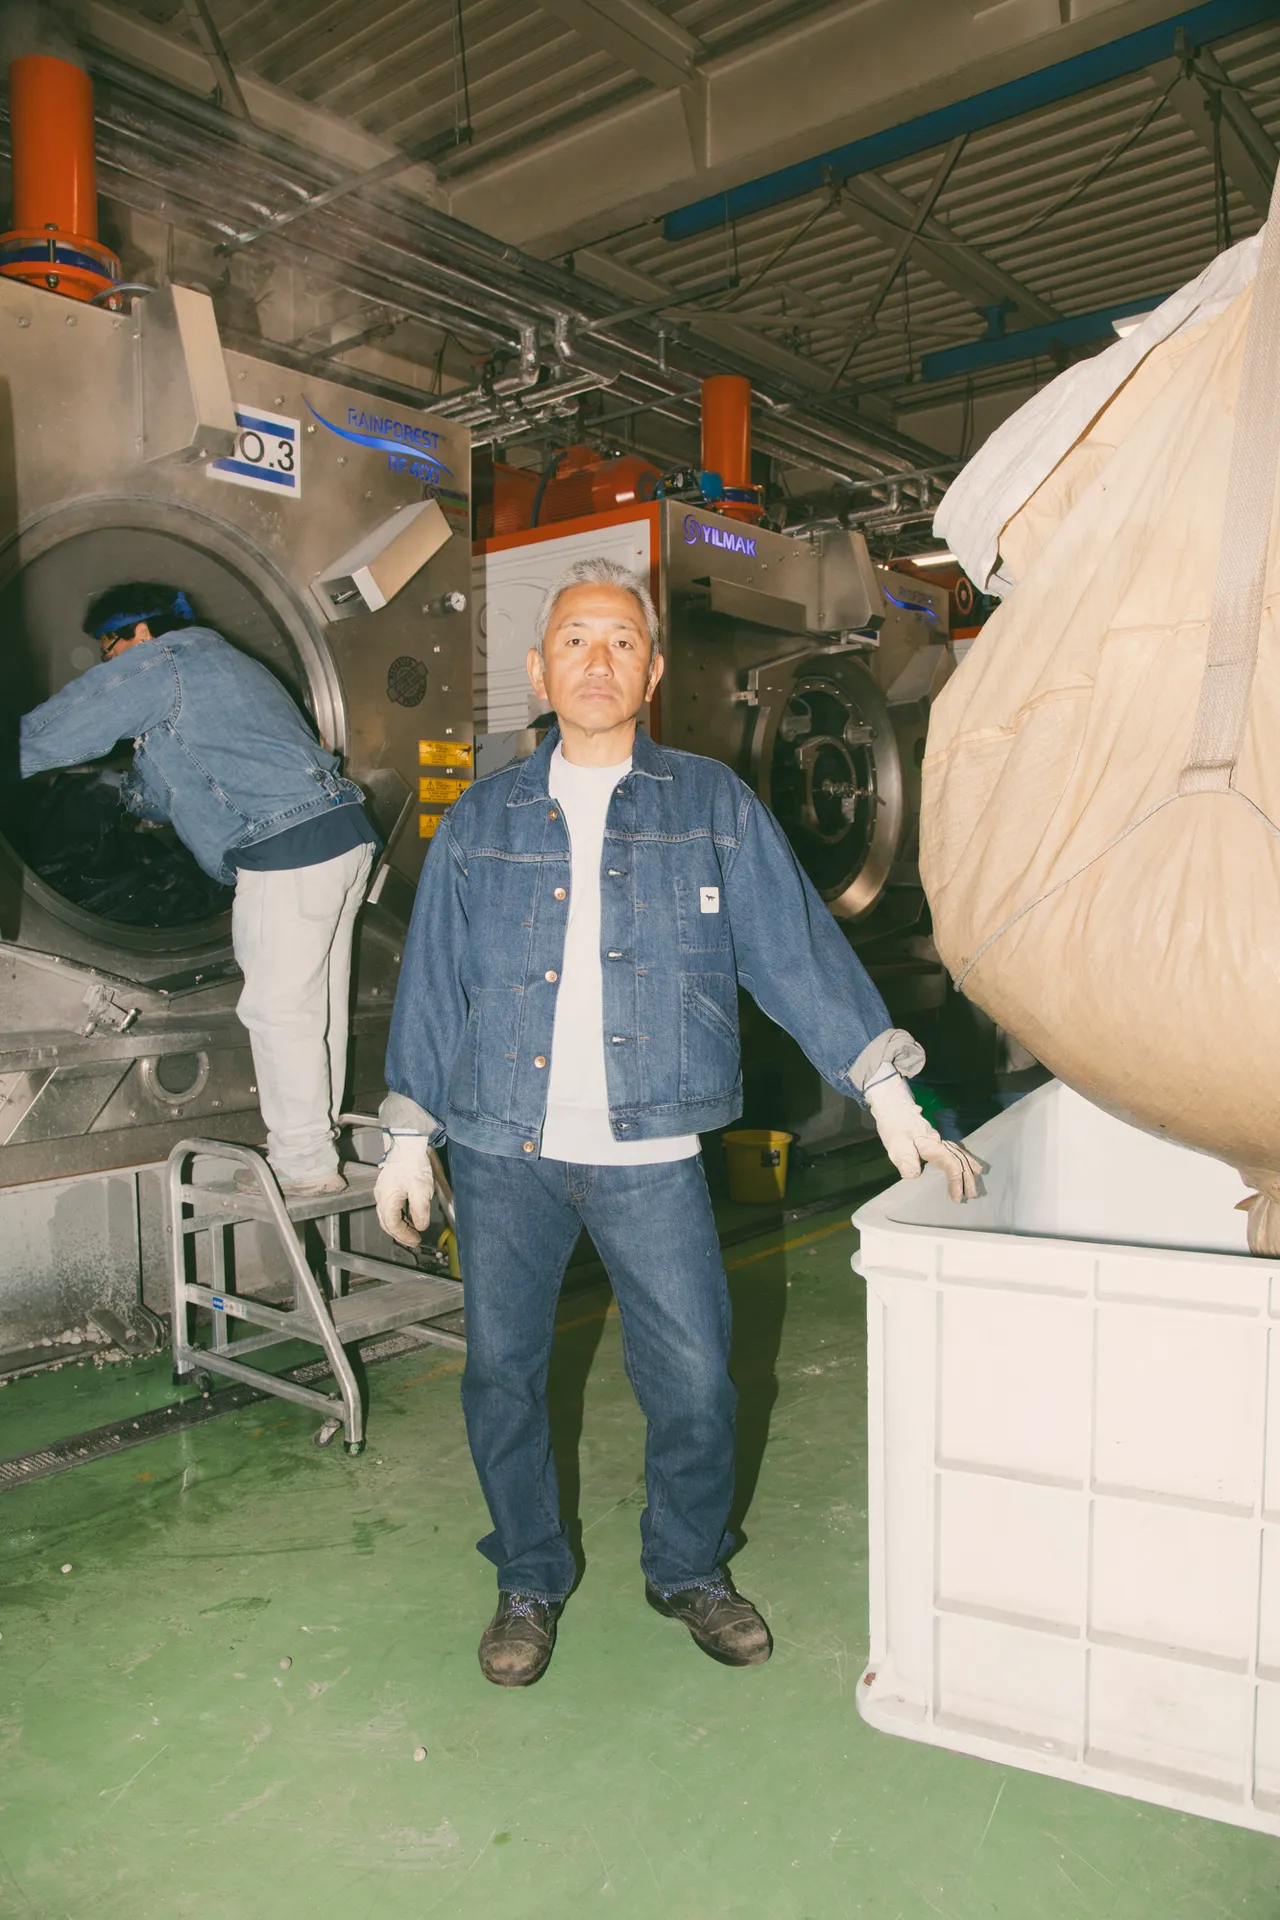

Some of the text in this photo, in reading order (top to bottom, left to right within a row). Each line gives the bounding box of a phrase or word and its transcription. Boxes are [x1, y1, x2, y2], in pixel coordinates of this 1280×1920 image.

[347, 408, 439, 451] RAINFOREST
[232, 430, 295, 472] O.3
[409, 461, 440, 484] 400
[701, 523, 757, 557] YILMAK
